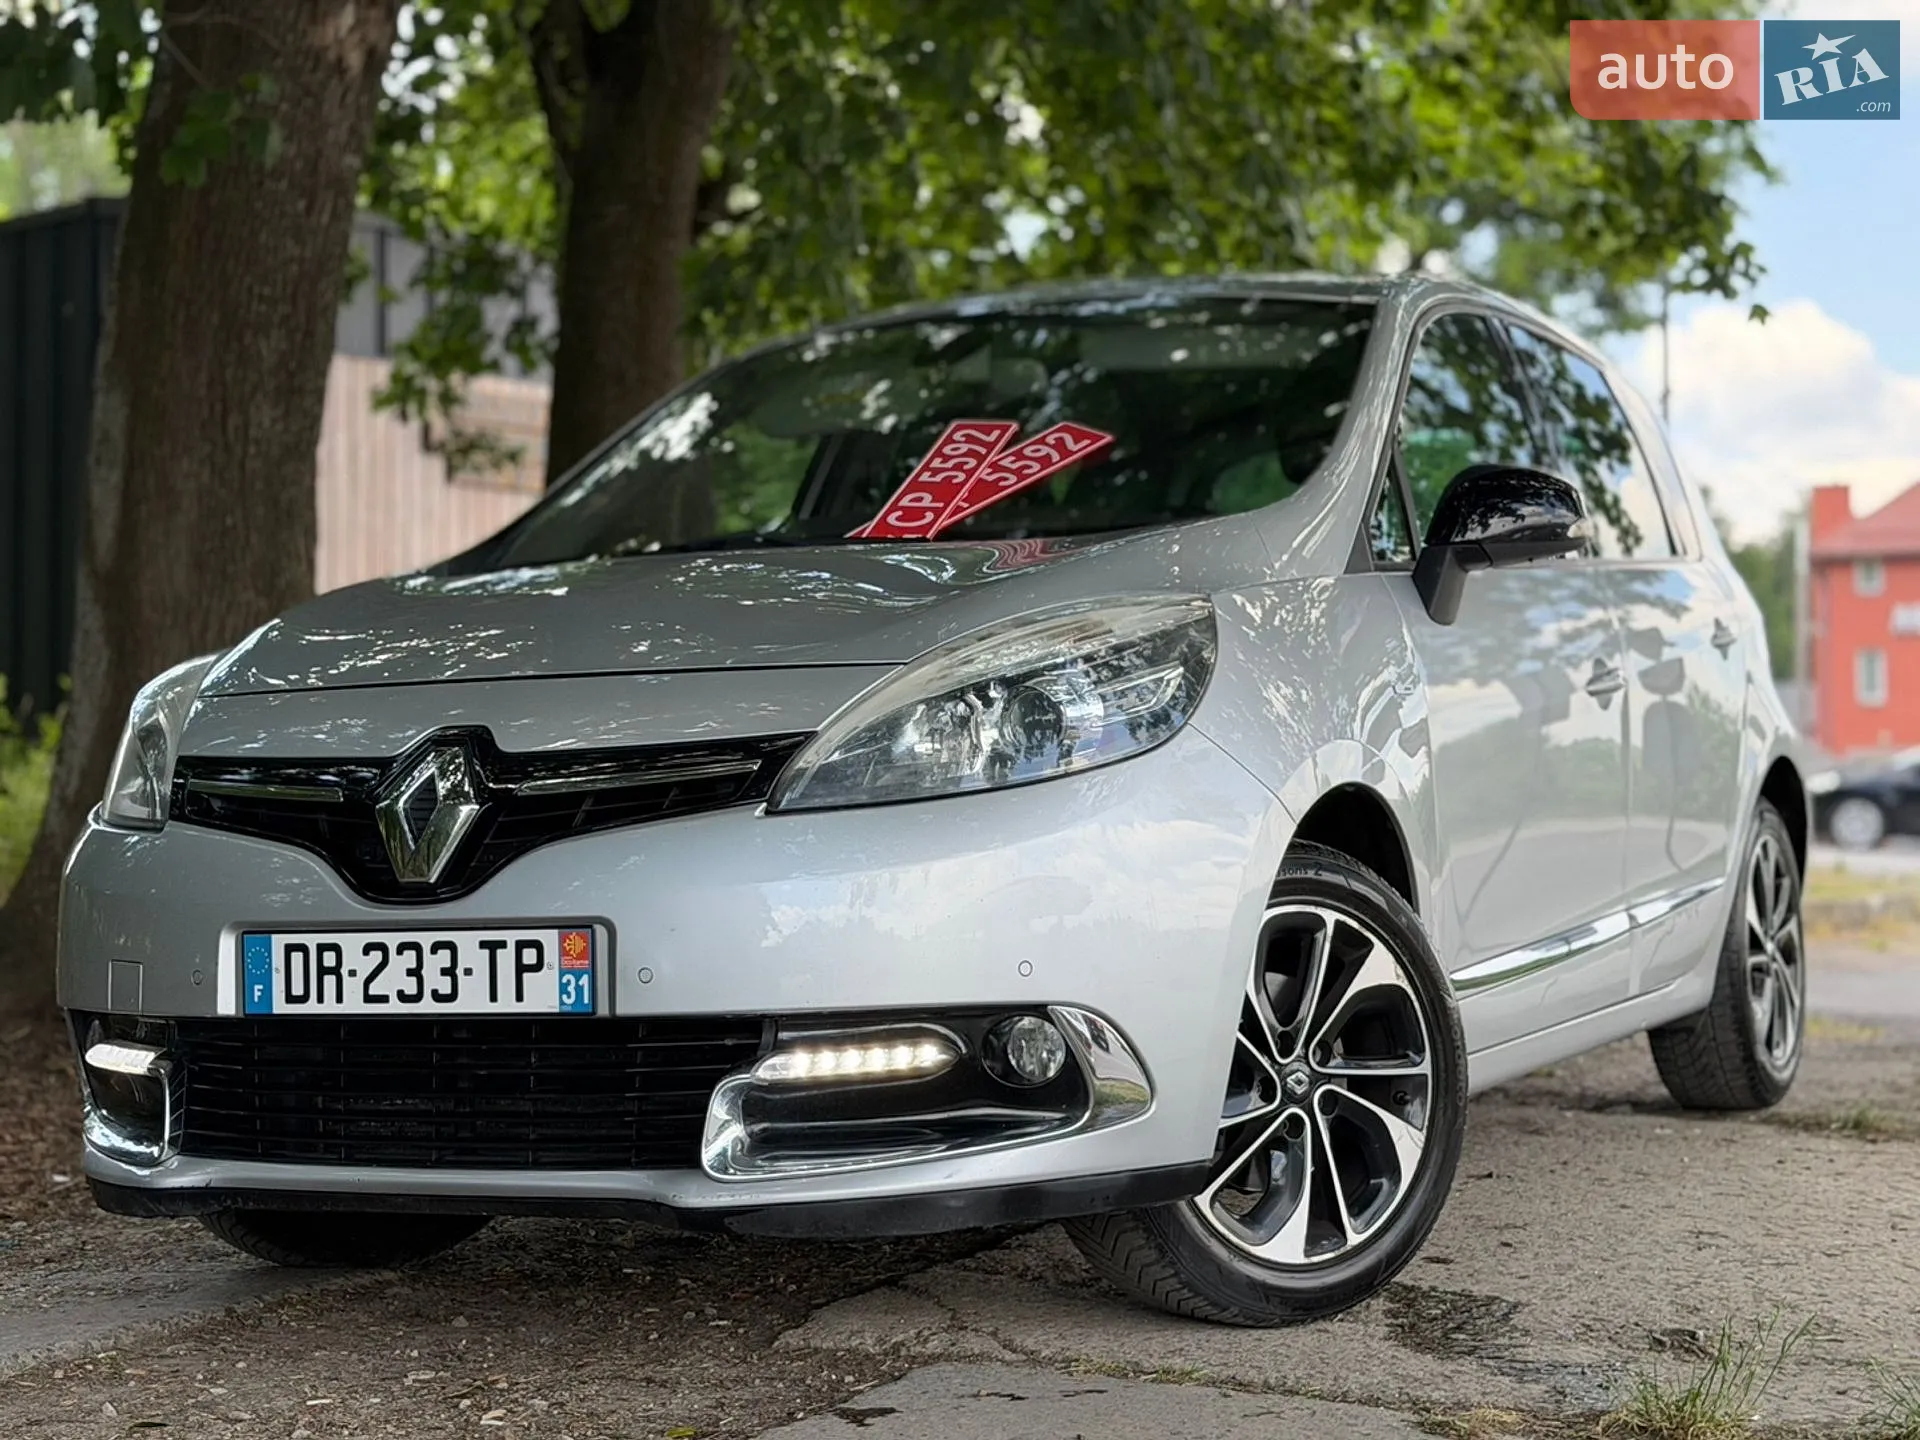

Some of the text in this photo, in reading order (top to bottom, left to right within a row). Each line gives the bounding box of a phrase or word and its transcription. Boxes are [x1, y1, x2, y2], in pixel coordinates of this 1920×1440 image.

[918, 429, 1001, 484] 5592
[980, 432, 1091, 487] 5592
[254, 985, 263, 1003] F
[284, 940, 544, 1004] DR-233-TP
[561, 973, 590, 1005] 31
